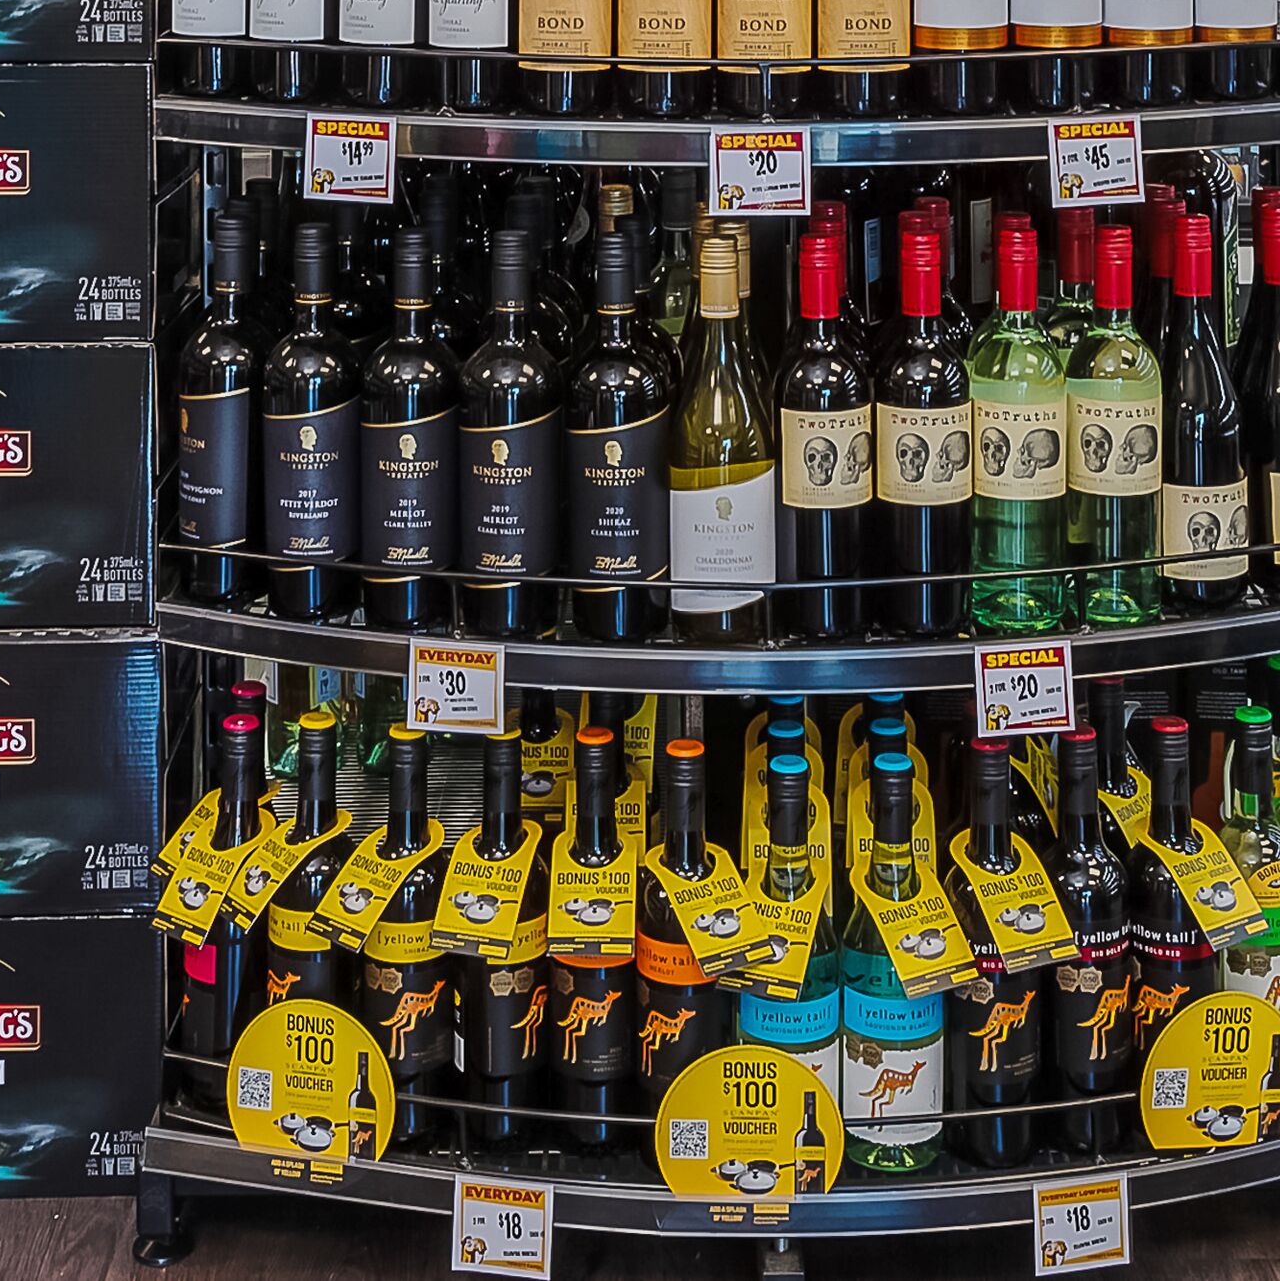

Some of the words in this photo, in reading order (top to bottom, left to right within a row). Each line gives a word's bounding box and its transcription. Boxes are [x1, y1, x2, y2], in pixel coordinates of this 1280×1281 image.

[80, 0, 101, 22] 24
[103, 10, 144, 22] BOTTLES
[538, 17, 584, 30] BOND
[638, 17, 686, 30] BOND
[740, 17, 786, 32] BOND
[844, 17, 892, 30] BOND
[317, 122, 384, 136] SPECIAL
[1059, 122, 1129, 138] SPECIAL
[721, 134, 796, 148] SPECIAL
[749, 150, 777, 176] $20
[1085, 143, 1110, 170] $45
[78, 277, 100, 301] 24
[101, 288, 142, 301] BOTTLES
[281, 451, 339, 464] KINGSTON
[379, 460, 438, 473] KINGSTON
[473, 466, 532, 479] KINGSTON
[585, 467, 645, 480] KINGSTON
[390, 509, 426, 518] MERLOT
[491, 505, 510, 513] 2019
[483, 516, 518, 524] MERLOT
[694, 523, 755, 534] KINGSTON
[80, 558, 101, 582] 24
[103, 569, 144, 582] BOTTLES
[419, 650, 494, 664] EVERYDAY
[987, 650, 1058, 667] SPECIAL
[439, 670, 465, 695] $30
[1011, 674, 1038, 701] $20
[453, 862, 493, 879] BONUS
[1174, 856, 1207, 878] BONUS
[557, 872, 599, 885] BONUS
[602, 872, 630, 885] $100
[486, 883, 518, 893] VOUCHER
[595, 886, 629, 894] VOUCHER
[674, 885, 712, 905] BONUS
[979, 880, 1019, 898] BONUS
[878, 903, 916, 926] BONUS
[1205, 1007, 1252, 1025] BONUS
[287, 1014, 334, 1035] BONUS
[1204, 1026, 1250, 1053] $100
[286, 1035, 334, 1065] $100
[723, 1061, 777, 1078] BONUS
[1201, 1067, 1247, 1081] VOUCHER
[285, 1075, 333, 1092] VOUCHER
[724, 1081, 777, 1108] $100
[723, 1122, 777, 1134] VOUCHER
[465, 1186, 543, 1203] EVERYDAY
[499, 1213, 522, 1239] $18
[1067, 1205, 1090, 1231] $18
